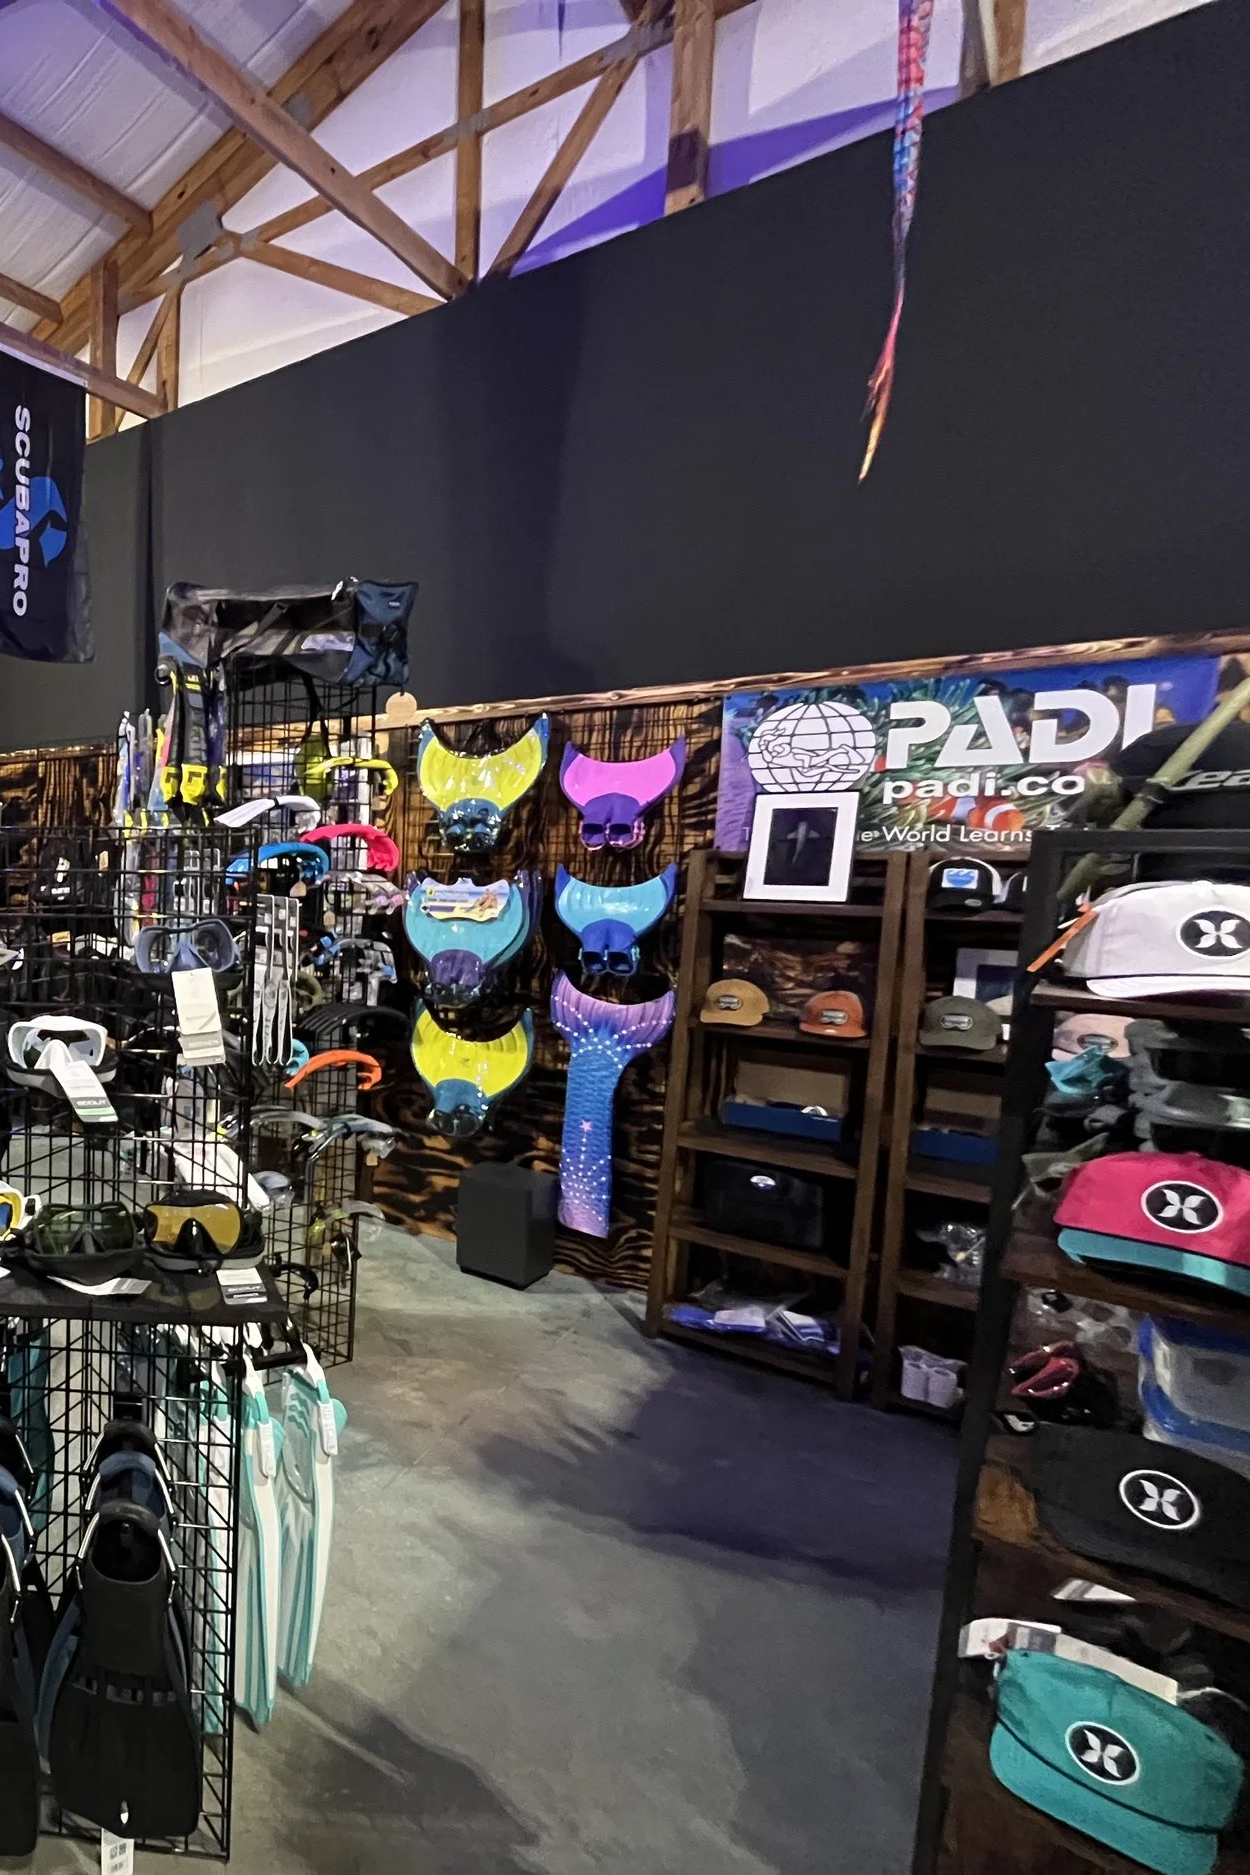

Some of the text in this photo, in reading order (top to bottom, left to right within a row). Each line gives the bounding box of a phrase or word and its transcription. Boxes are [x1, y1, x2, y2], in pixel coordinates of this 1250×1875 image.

[13, 404, 31, 617] SCUBAPRO
[885, 683, 1156, 770] PADI
[883, 773, 1085, 805] padi.co
[882, 824, 951, 843] World
[959, 824, 1032, 843] Learns
